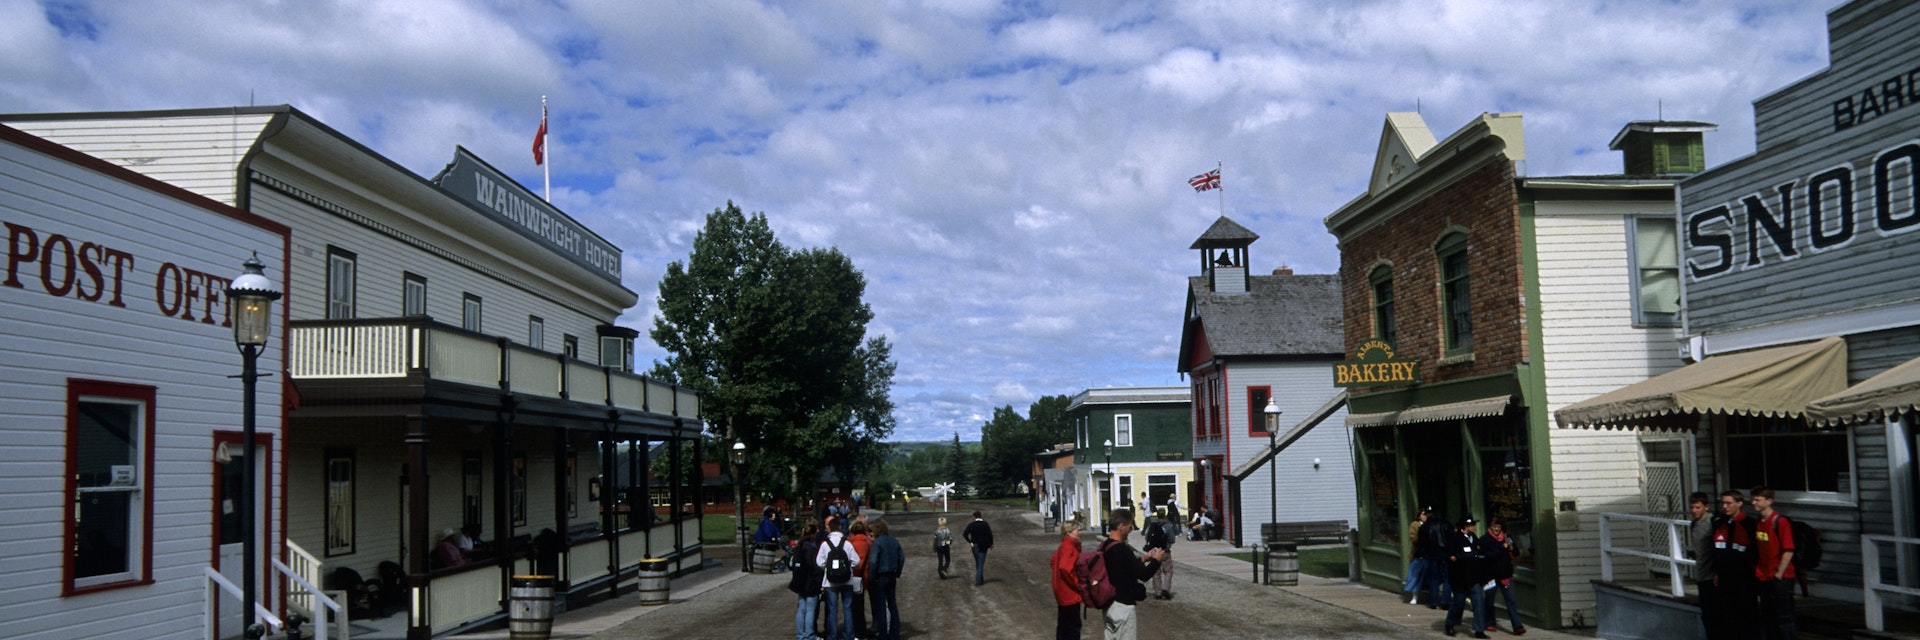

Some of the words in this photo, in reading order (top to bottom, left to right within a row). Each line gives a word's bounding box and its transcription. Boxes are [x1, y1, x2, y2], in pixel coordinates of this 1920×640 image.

[475, 171, 581, 256] WAINWRIGHT
[585, 239, 621, 280] HOTEL
[1686, 139, 1920, 282] SNOO
[3, 221, 134, 308] POST
[156, 262, 233, 328] OFFI
[1336, 362, 1417, 384] BAKERY
[1357, 341, 1394, 360] ALBERTA
